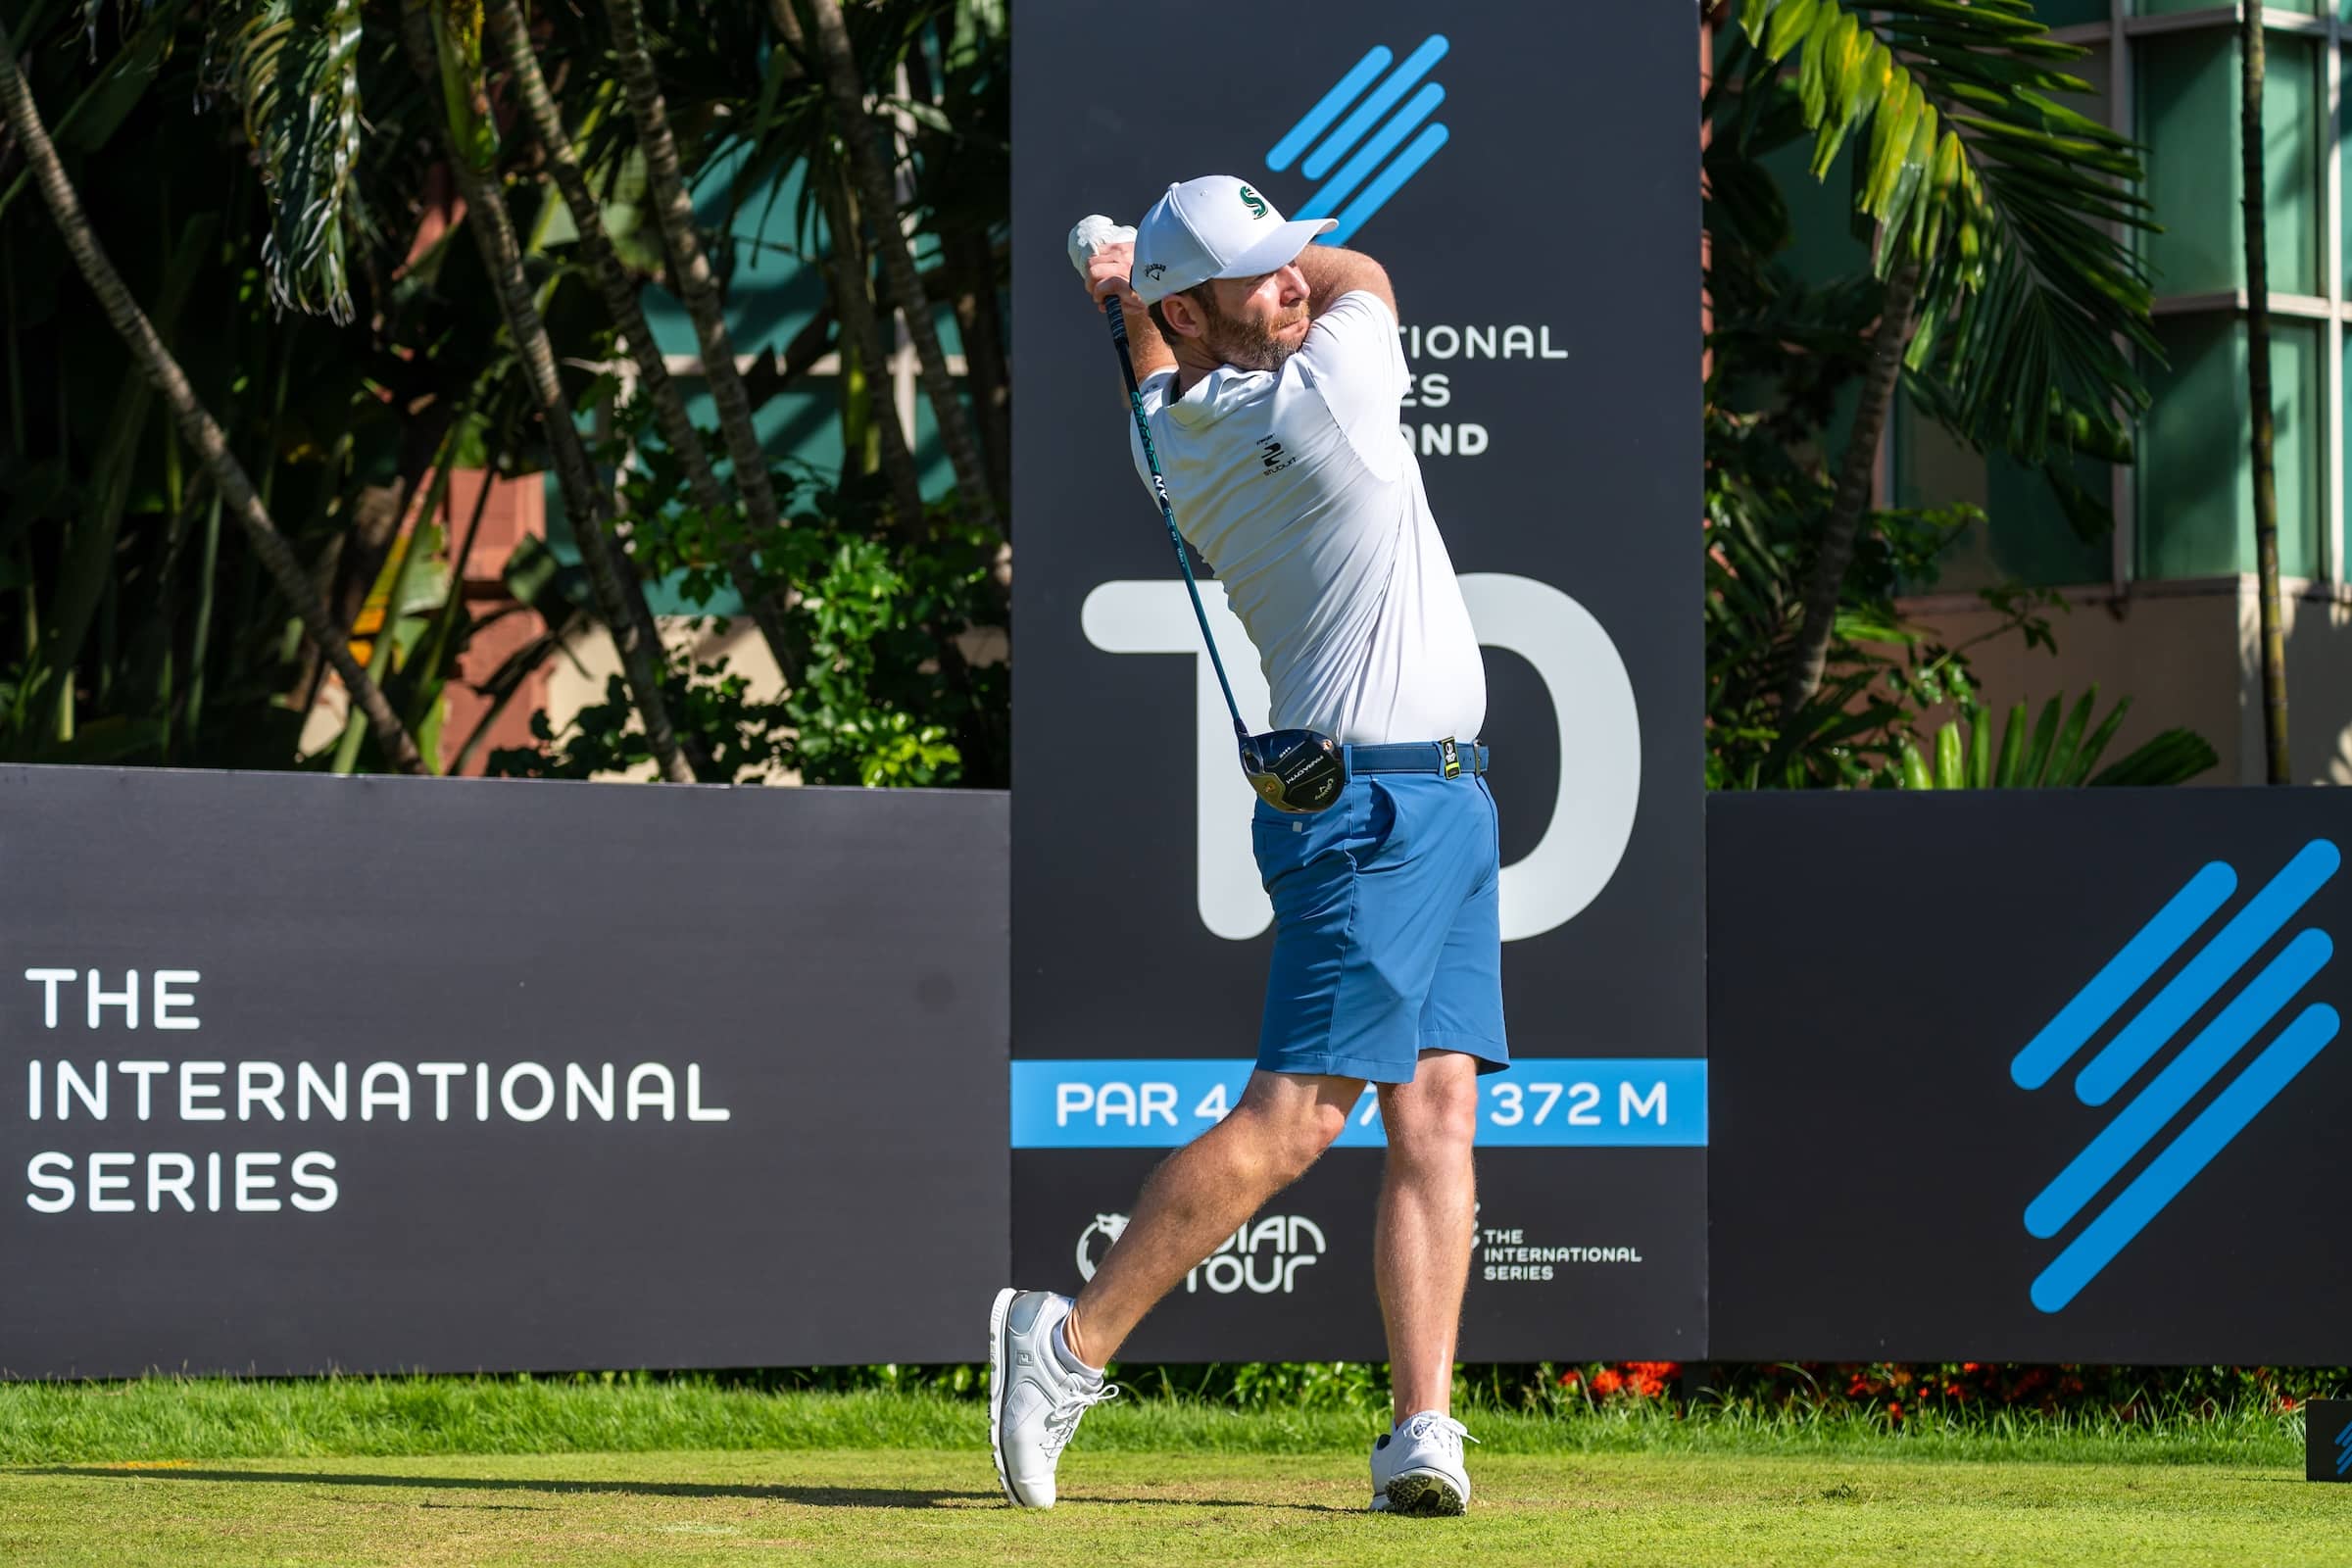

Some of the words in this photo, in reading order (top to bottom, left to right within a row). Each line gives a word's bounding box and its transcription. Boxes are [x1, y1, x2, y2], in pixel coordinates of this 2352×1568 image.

[1399, 325, 1568, 360] IONAL
[25, 968, 201, 1029] THE
[28, 1060, 730, 1121] INTERNATIONAL
[1057, 1083, 1178, 1126] PAR
[1195, 1083, 1231, 1123] 4
[1491, 1082, 1600, 1126] 372
[1620, 1081, 1667, 1126] M
[26, 1152, 338, 1212] SERIES
[1484, 1229, 1523, 1245] THE
[1484, 1247, 1642, 1262] INTERNATIONAL
[1484, 1265, 1554, 1281] SERIES
